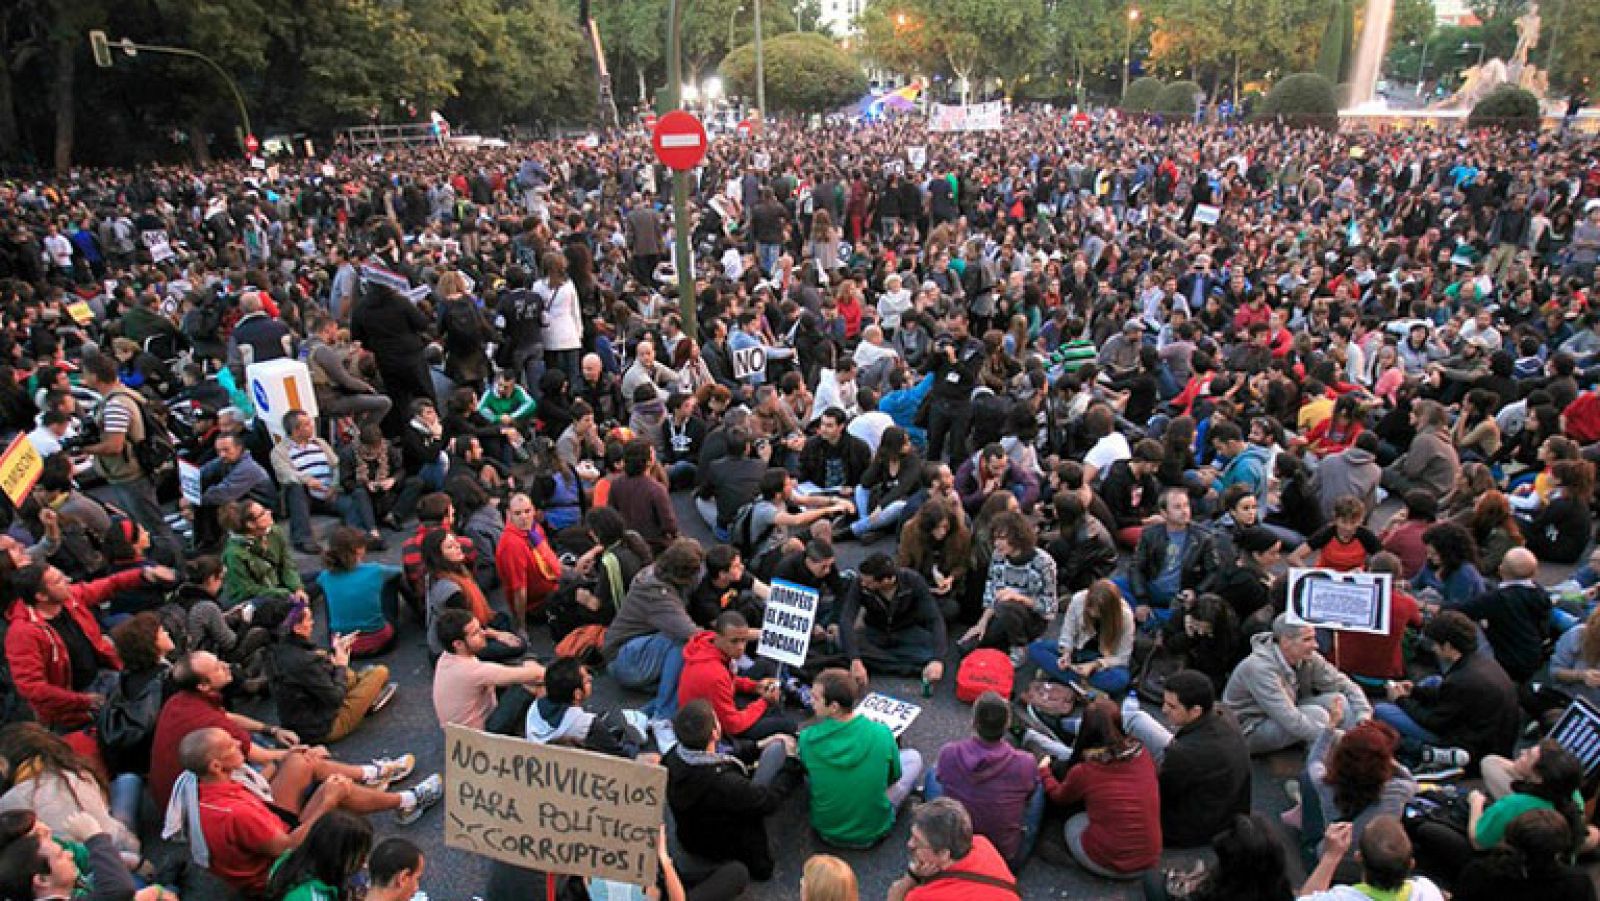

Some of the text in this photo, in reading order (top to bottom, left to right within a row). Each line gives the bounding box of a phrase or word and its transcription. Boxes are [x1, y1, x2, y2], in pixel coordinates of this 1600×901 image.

[737, 348, 766, 375] NO
[777, 610, 809, 633] PACTO
[863, 696, 915, 720] GOLPE
[459, 781, 660, 847] PARA POLÍTICOS
